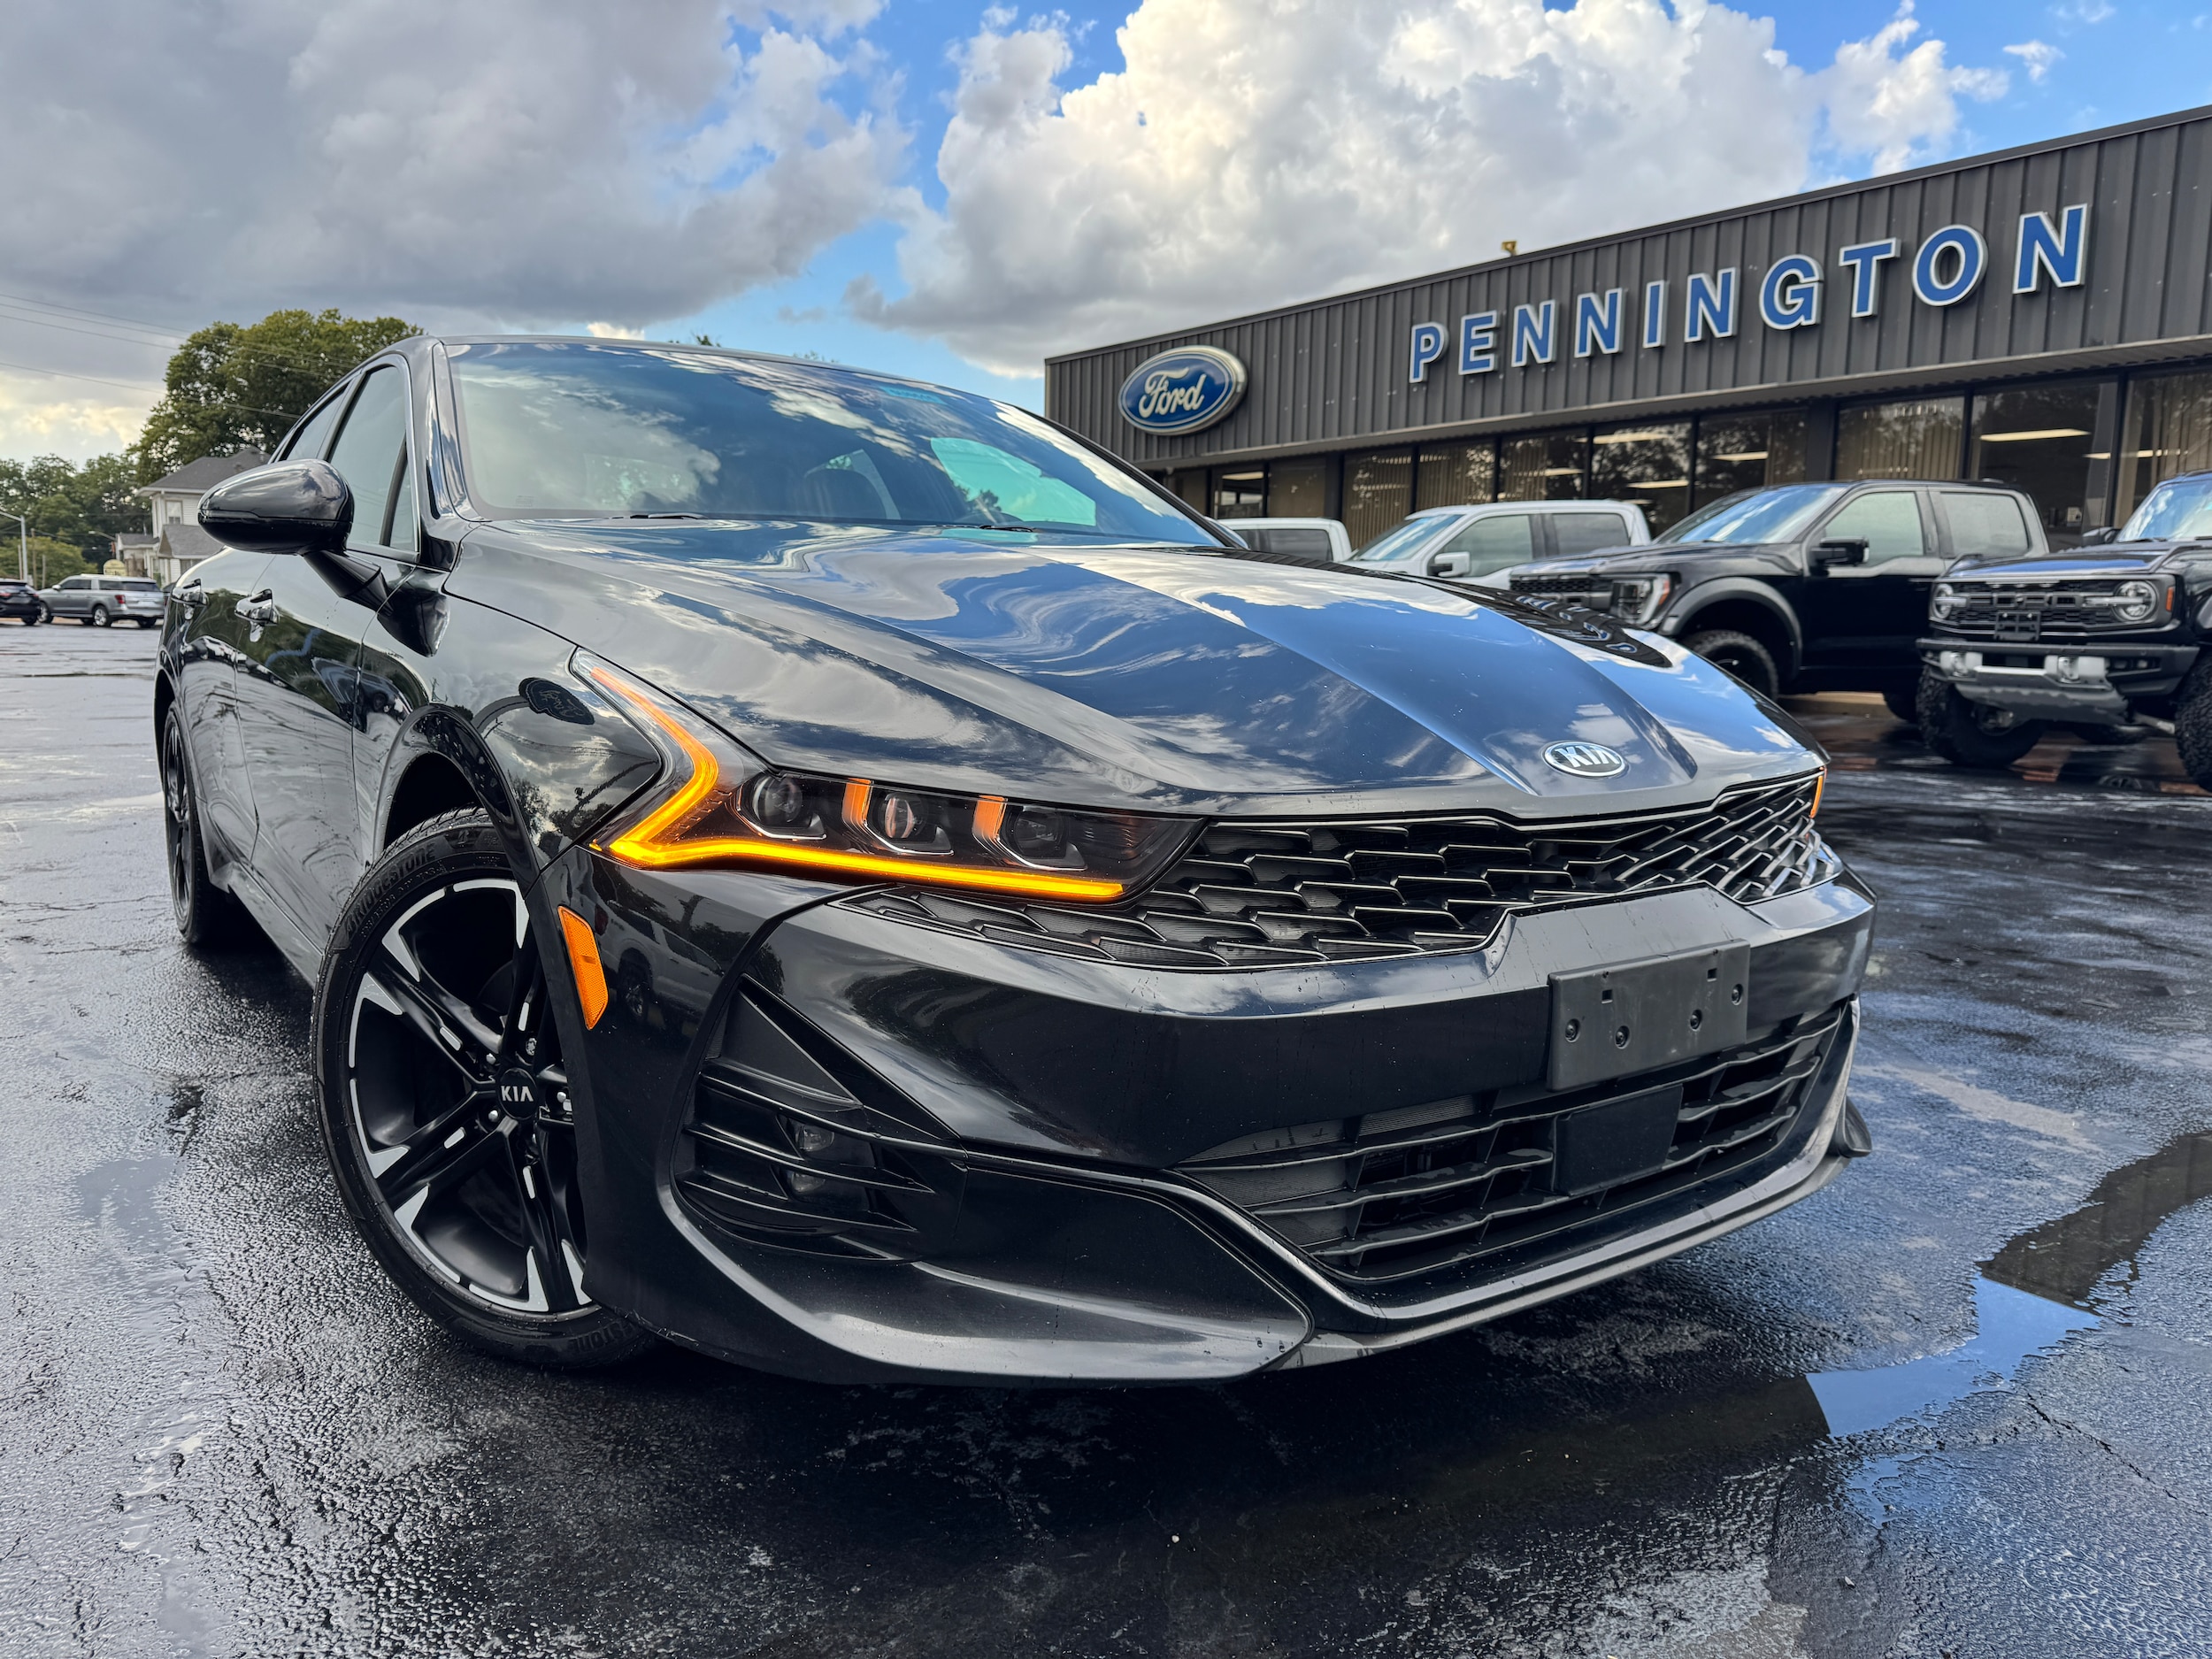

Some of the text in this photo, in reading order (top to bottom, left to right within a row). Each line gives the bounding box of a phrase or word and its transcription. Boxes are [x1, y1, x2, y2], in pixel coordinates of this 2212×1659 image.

[1409, 203, 2089, 383] PENNINGTON
[1138, 366, 1207, 418] Ford
[1554, 745, 1620, 768] KIA
[501, 1085, 534, 1102] KIA
